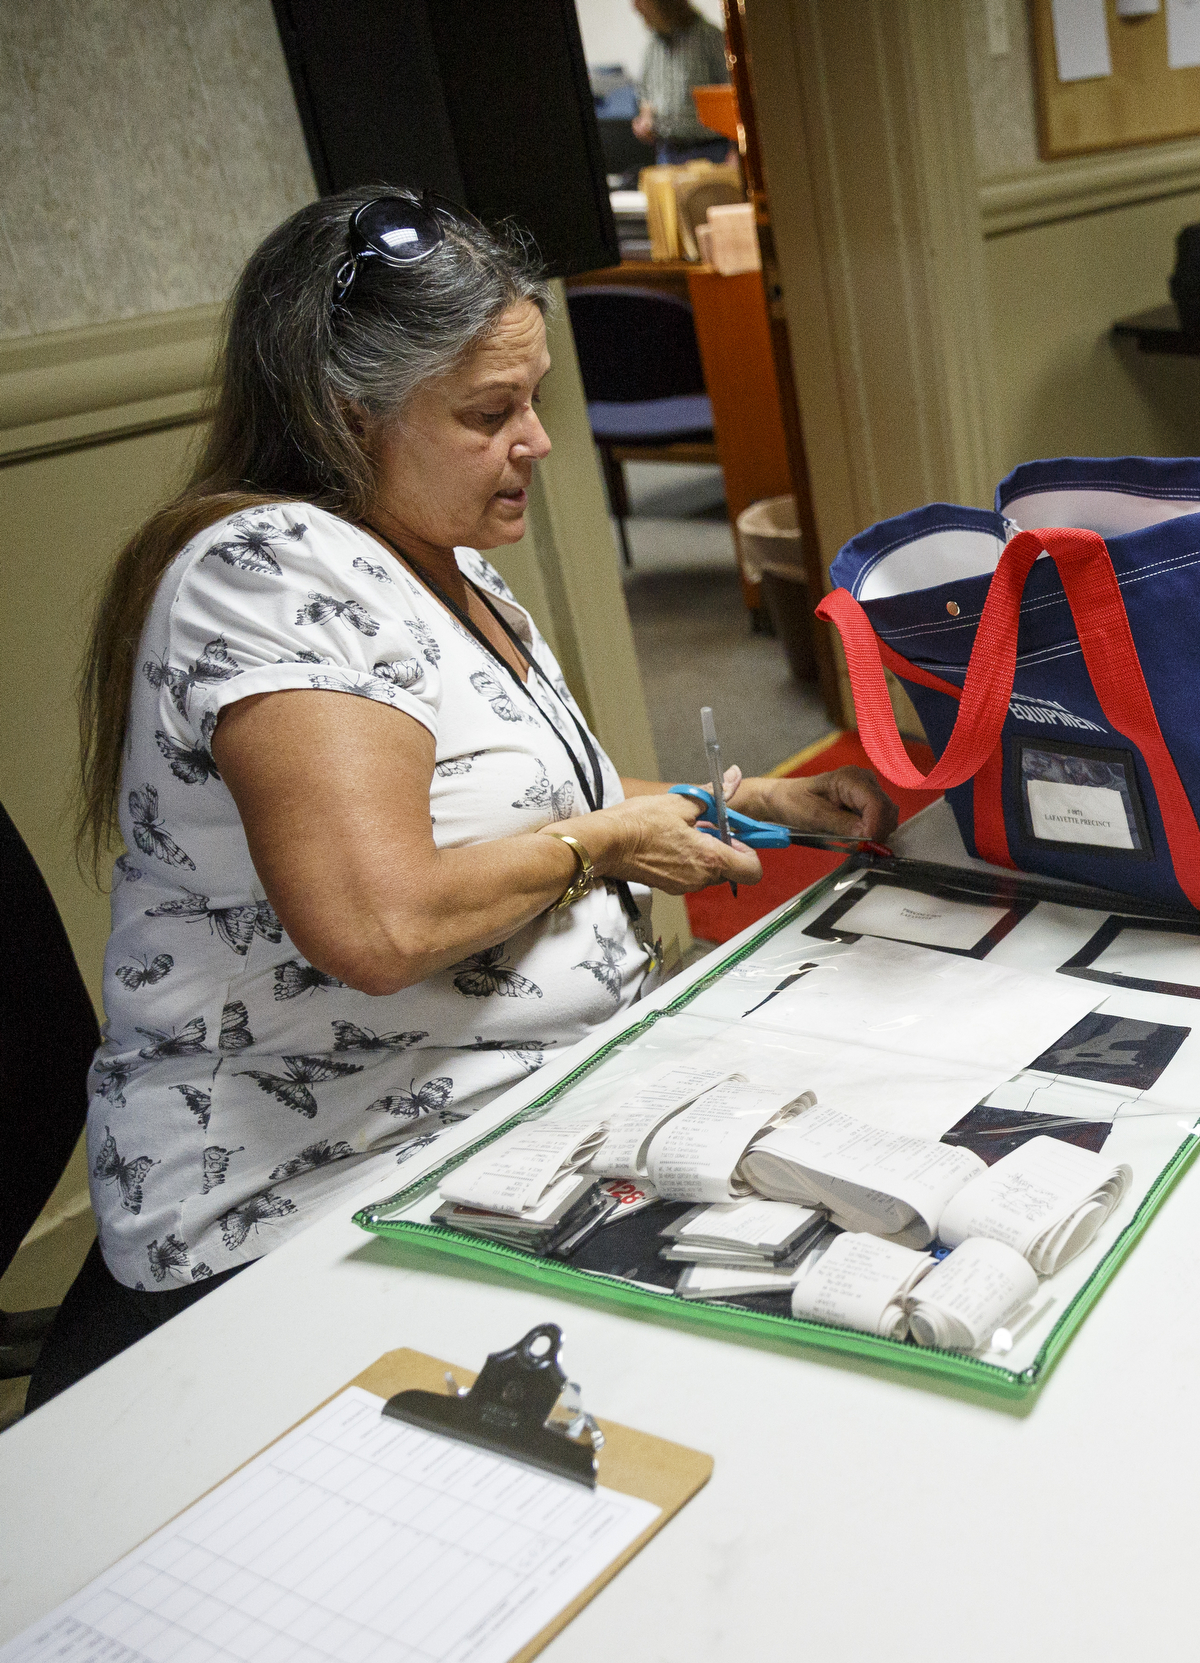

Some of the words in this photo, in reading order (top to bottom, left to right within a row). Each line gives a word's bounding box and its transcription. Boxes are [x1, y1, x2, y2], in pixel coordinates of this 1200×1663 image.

[1008, 702, 1108, 734] EQUIPMENT
[1044, 814, 1080, 825] LAFAYETTE
[1080, 818, 1111, 828] PRECINCT
[606, 1180, 645, 1204] 128
